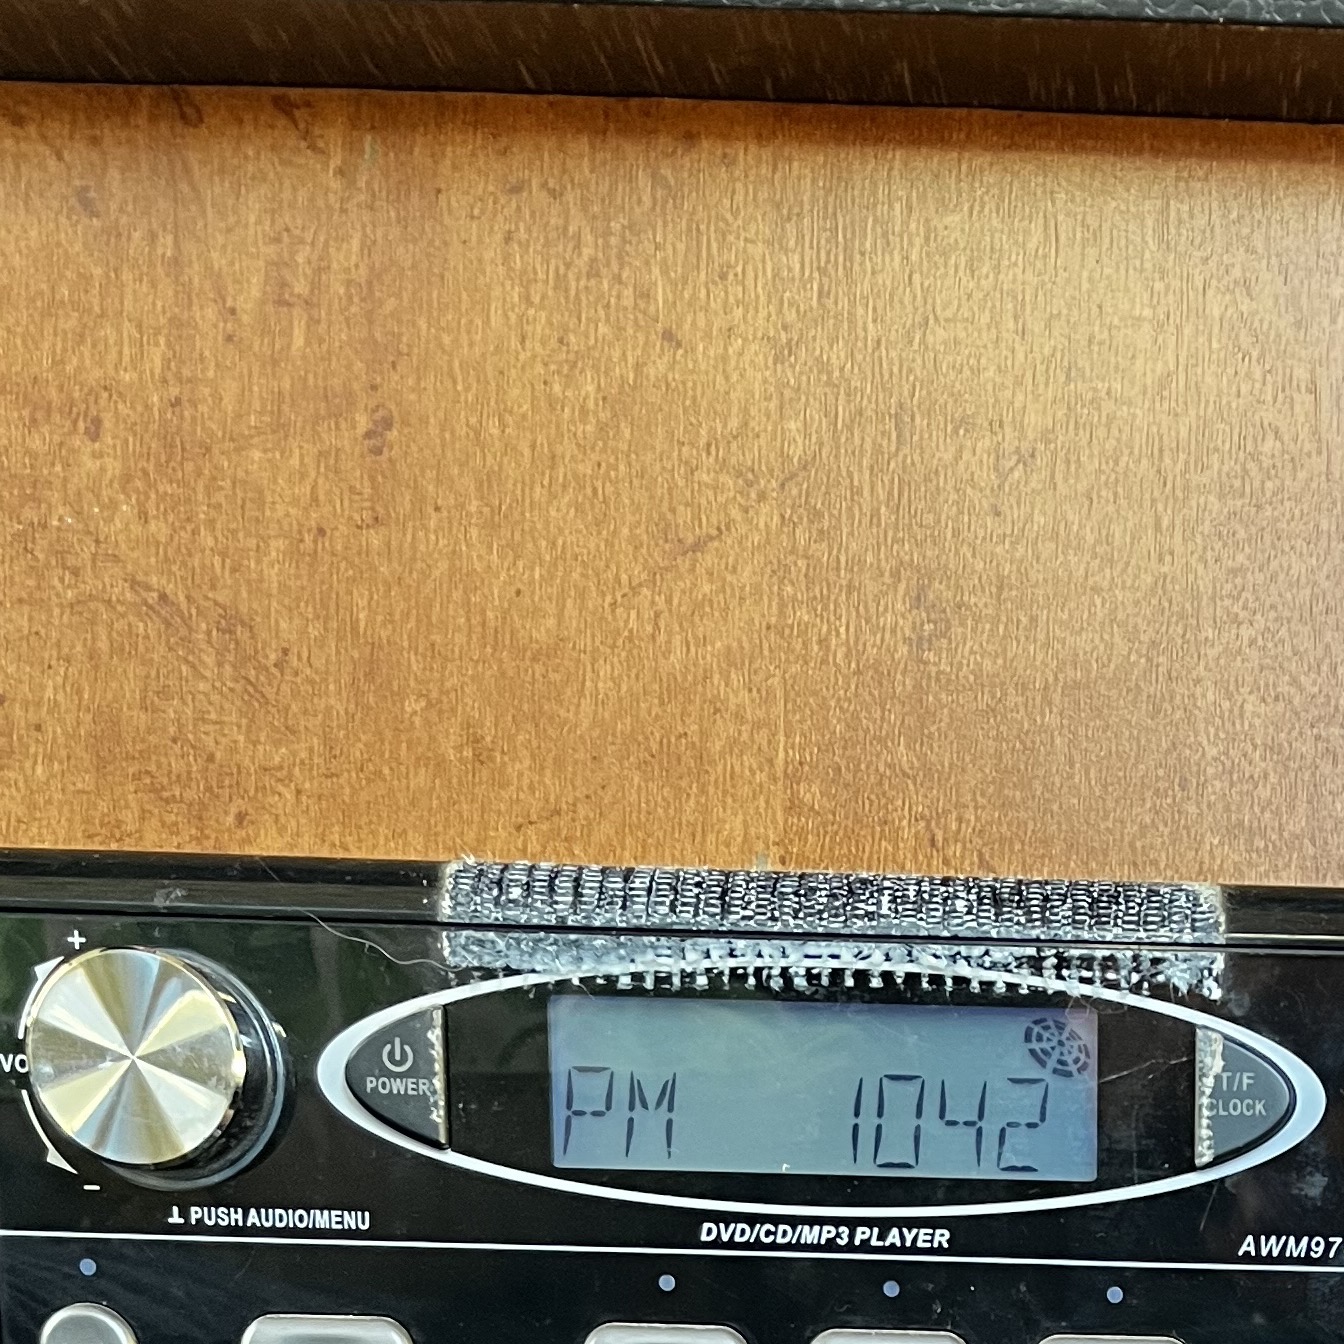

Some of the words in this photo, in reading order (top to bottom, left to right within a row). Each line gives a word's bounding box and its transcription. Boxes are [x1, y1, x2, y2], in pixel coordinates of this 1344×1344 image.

[0, 1053, 29, 1074] VO
[366, 1077, 430, 1096] POWER
[1221, 1071, 1256, 1092] T/F
[564, 1065, 677, 1160] PM
[1206, 1098, 1267, 1117] CLOCK
[189, 1206, 243, 1226] PUSH
[246, 1207, 371, 1231] AUDIO/MENU
[700, 1222, 850, 1246] DVD/CD/MP3
[853, 1226, 951, 1249] PLAYER
